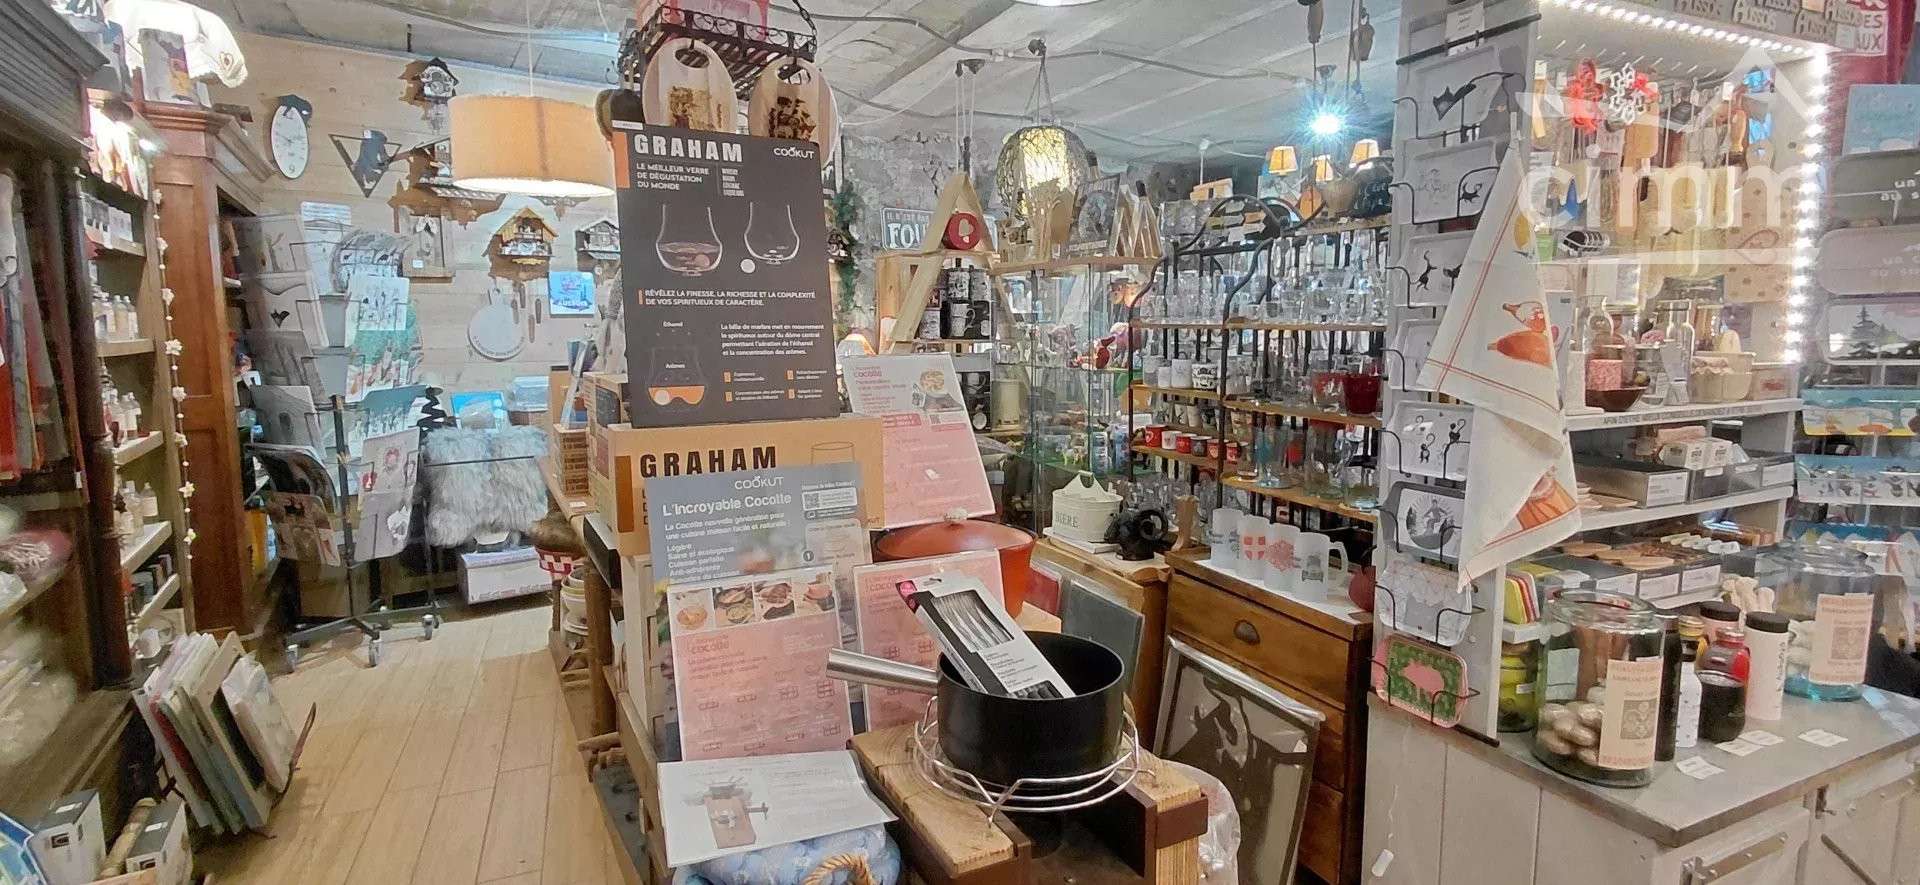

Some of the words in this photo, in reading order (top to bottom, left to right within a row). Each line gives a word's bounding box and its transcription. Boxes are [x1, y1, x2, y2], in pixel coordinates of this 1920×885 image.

[634, 134, 742, 162] GRAHAM
[773, 146, 814, 160] COOKUT
[636, 162, 646, 170] LE
[647, 163, 684, 173] MEILLEUR
[685, 166, 710, 175] VERRE
[637, 171, 648, 179] DE
[637, 180, 649, 189] DU
[650, 182, 680, 191] MONDE
[640, 446, 776, 478] GRAHAM
[735, 475, 784, 490] COOKUT
[744, 493, 792, 508] Cocotte
